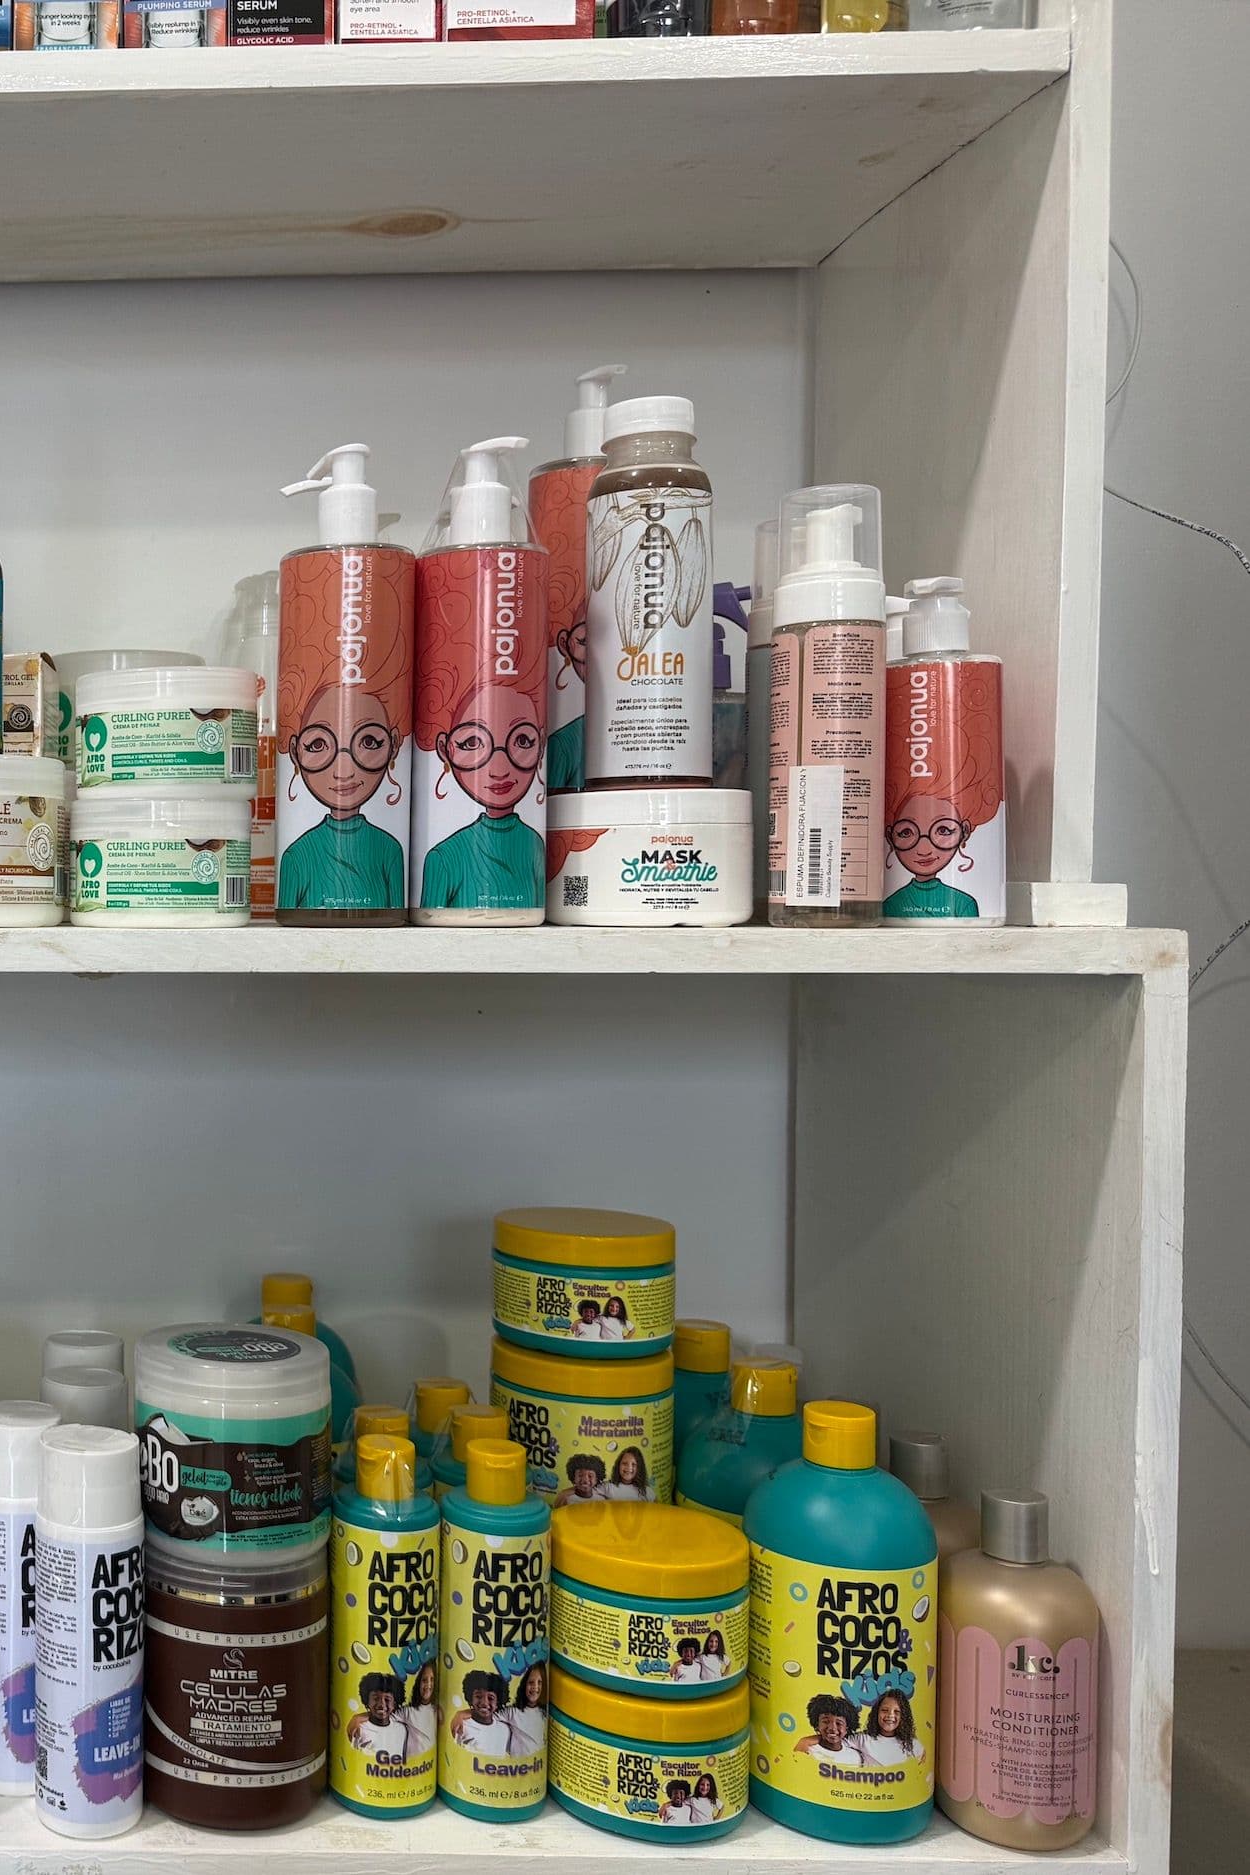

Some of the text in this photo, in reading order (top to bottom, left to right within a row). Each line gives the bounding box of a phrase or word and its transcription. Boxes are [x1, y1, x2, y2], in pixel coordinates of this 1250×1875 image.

[138, 3, 179, 11] PLUMPING
[237, 0, 277, 11] SERUM
[274, 36, 294, 44] ACID
[516, 553, 525, 586] nature
[639, 502, 672, 631] pajonua
[337, 555, 367, 684] pajonua
[491, 552, 519, 676] pajonua
[516, 602, 525, 618] love
[631, 678, 684, 687] CHOCOLATE
[111, 711, 191, 724] CURLING PUREE
[905, 671, 933, 778] pajonua
[86, 754, 106, 764] AFRO
[86, 763, 106, 774] LOVE
[106, 842, 186, 852] CURLING PUREE
[651, 835, 694, 845] pajonua
[797, 813, 806, 862] DEFINIDORA
[641, 850, 702, 865] MASK
[621, 858, 718, 884] Smoothie
[796, 865, 804, 898] ESPUMA
[536, 1275, 566, 1293] AFRO
[572, 1282, 609, 1294] Escultor
[536, 1288, 567, 1306] COCO
[574, 1290, 612, 1299] de Rizos
[536, 1300, 571, 1318] RIZOS
[578, 1425, 645, 1439] Hidratante
[580, 1415, 645, 1430] Mascarilla
[367, 1549, 435, 1584] AFRO
[472, 1549, 543, 1584] AFRO
[367, 1579, 436, 1618] COCO
[472, 1580, 544, 1618] COCO
[816, 1577, 899, 1615] AFRO
[367, 1613, 438, 1649] RIZOS
[472, 1612, 547, 1649] RIZOS
[816, 1610, 902, 1651] COCO
[816, 1643, 909, 1681] RIZOS
[210, 1668, 258, 1681] MITRE
[179, 1679, 288, 1700] CELULAS
[841, 1668, 916, 1710] Kids
[189, 1695, 278, 1714] MADRES
[195, 1711, 273, 1723] ADVANCED REPAIR
[989, 1706, 1081, 1725] MOISTURIZING
[200, 1720, 272, 1732] TRATAMIENTO
[991, 1719, 1080, 1737] CONDITIONER
[170, 1733, 229, 1767] CHOCOLATE
[375, 1750, 407, 1767] Gel
[366, 1759, 433, 1780] Moldeador
[472, 1756, 543, 1778] Leave-in
[818, 1762, 905, 1788] Shampoo
